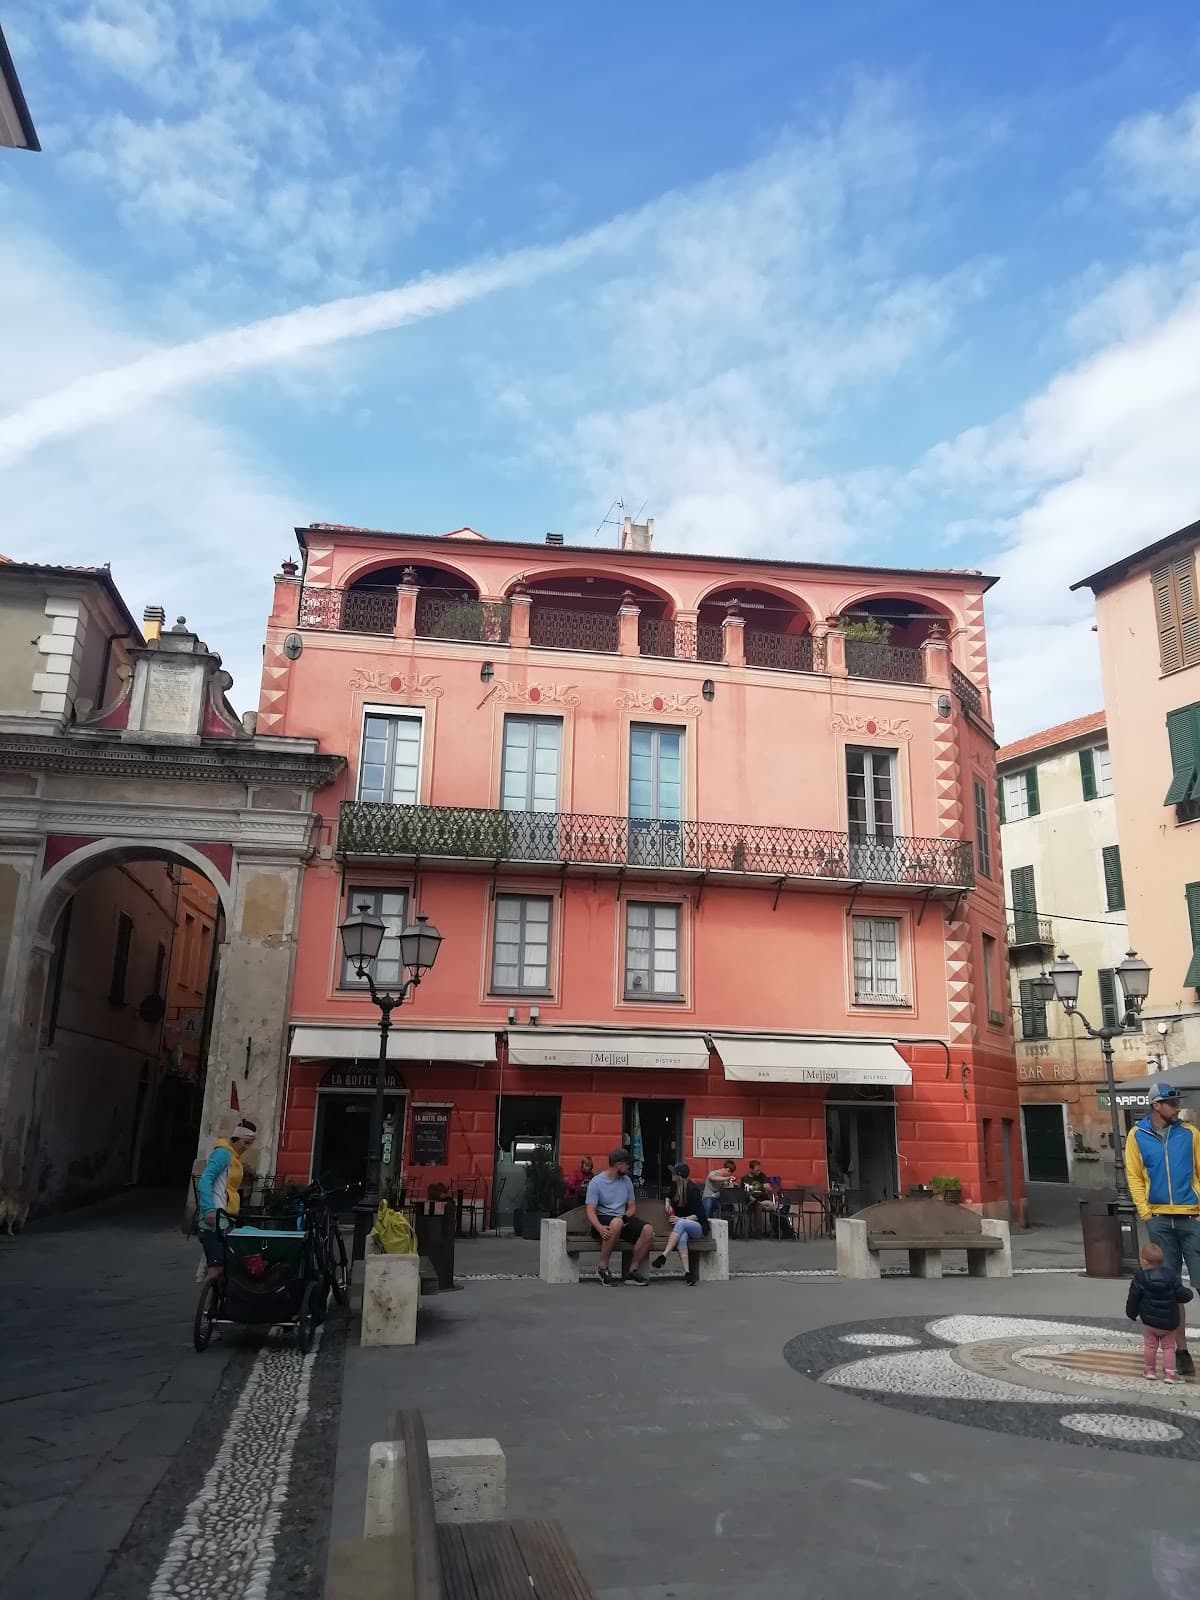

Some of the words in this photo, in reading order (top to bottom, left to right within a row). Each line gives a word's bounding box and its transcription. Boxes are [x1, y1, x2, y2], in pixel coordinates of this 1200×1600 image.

[1019, 1066, 1045, 1080] BAR
[331, 1074, 342, 1085] LA
[345, 1074, 373, 1086] BOTTE
